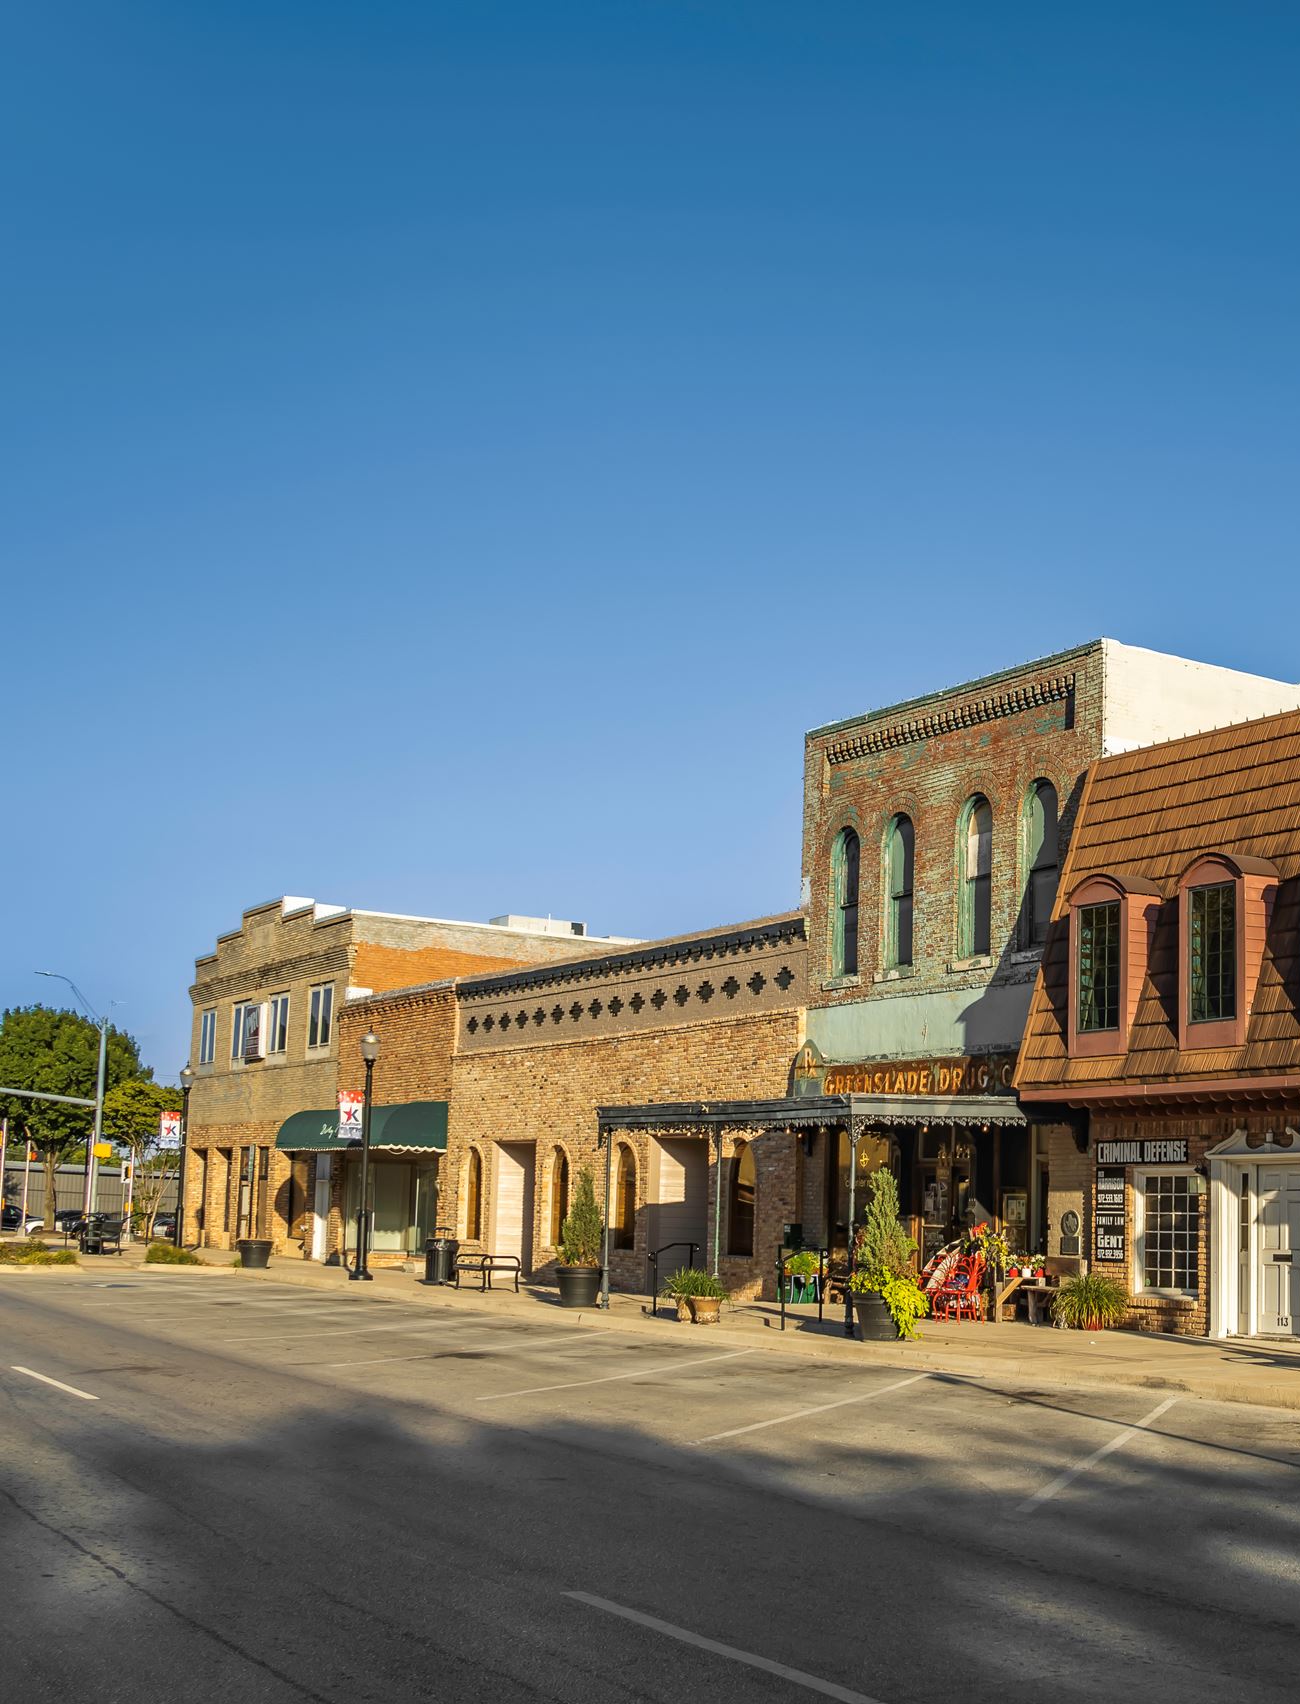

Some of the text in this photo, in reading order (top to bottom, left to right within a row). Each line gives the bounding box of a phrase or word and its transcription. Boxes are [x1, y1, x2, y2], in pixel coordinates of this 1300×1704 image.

[824, 1064, 1013, 1096] GREENSLADE DRUG C
[1098, 1140, 1187, 1163] CRIMINAL DEFENSE
[1096, 1216, 1125, 1226] FAMILY LAW
[1097, 1235, 1124, 1248] GENT
[1277, 1316, 1289, 1327] 113
